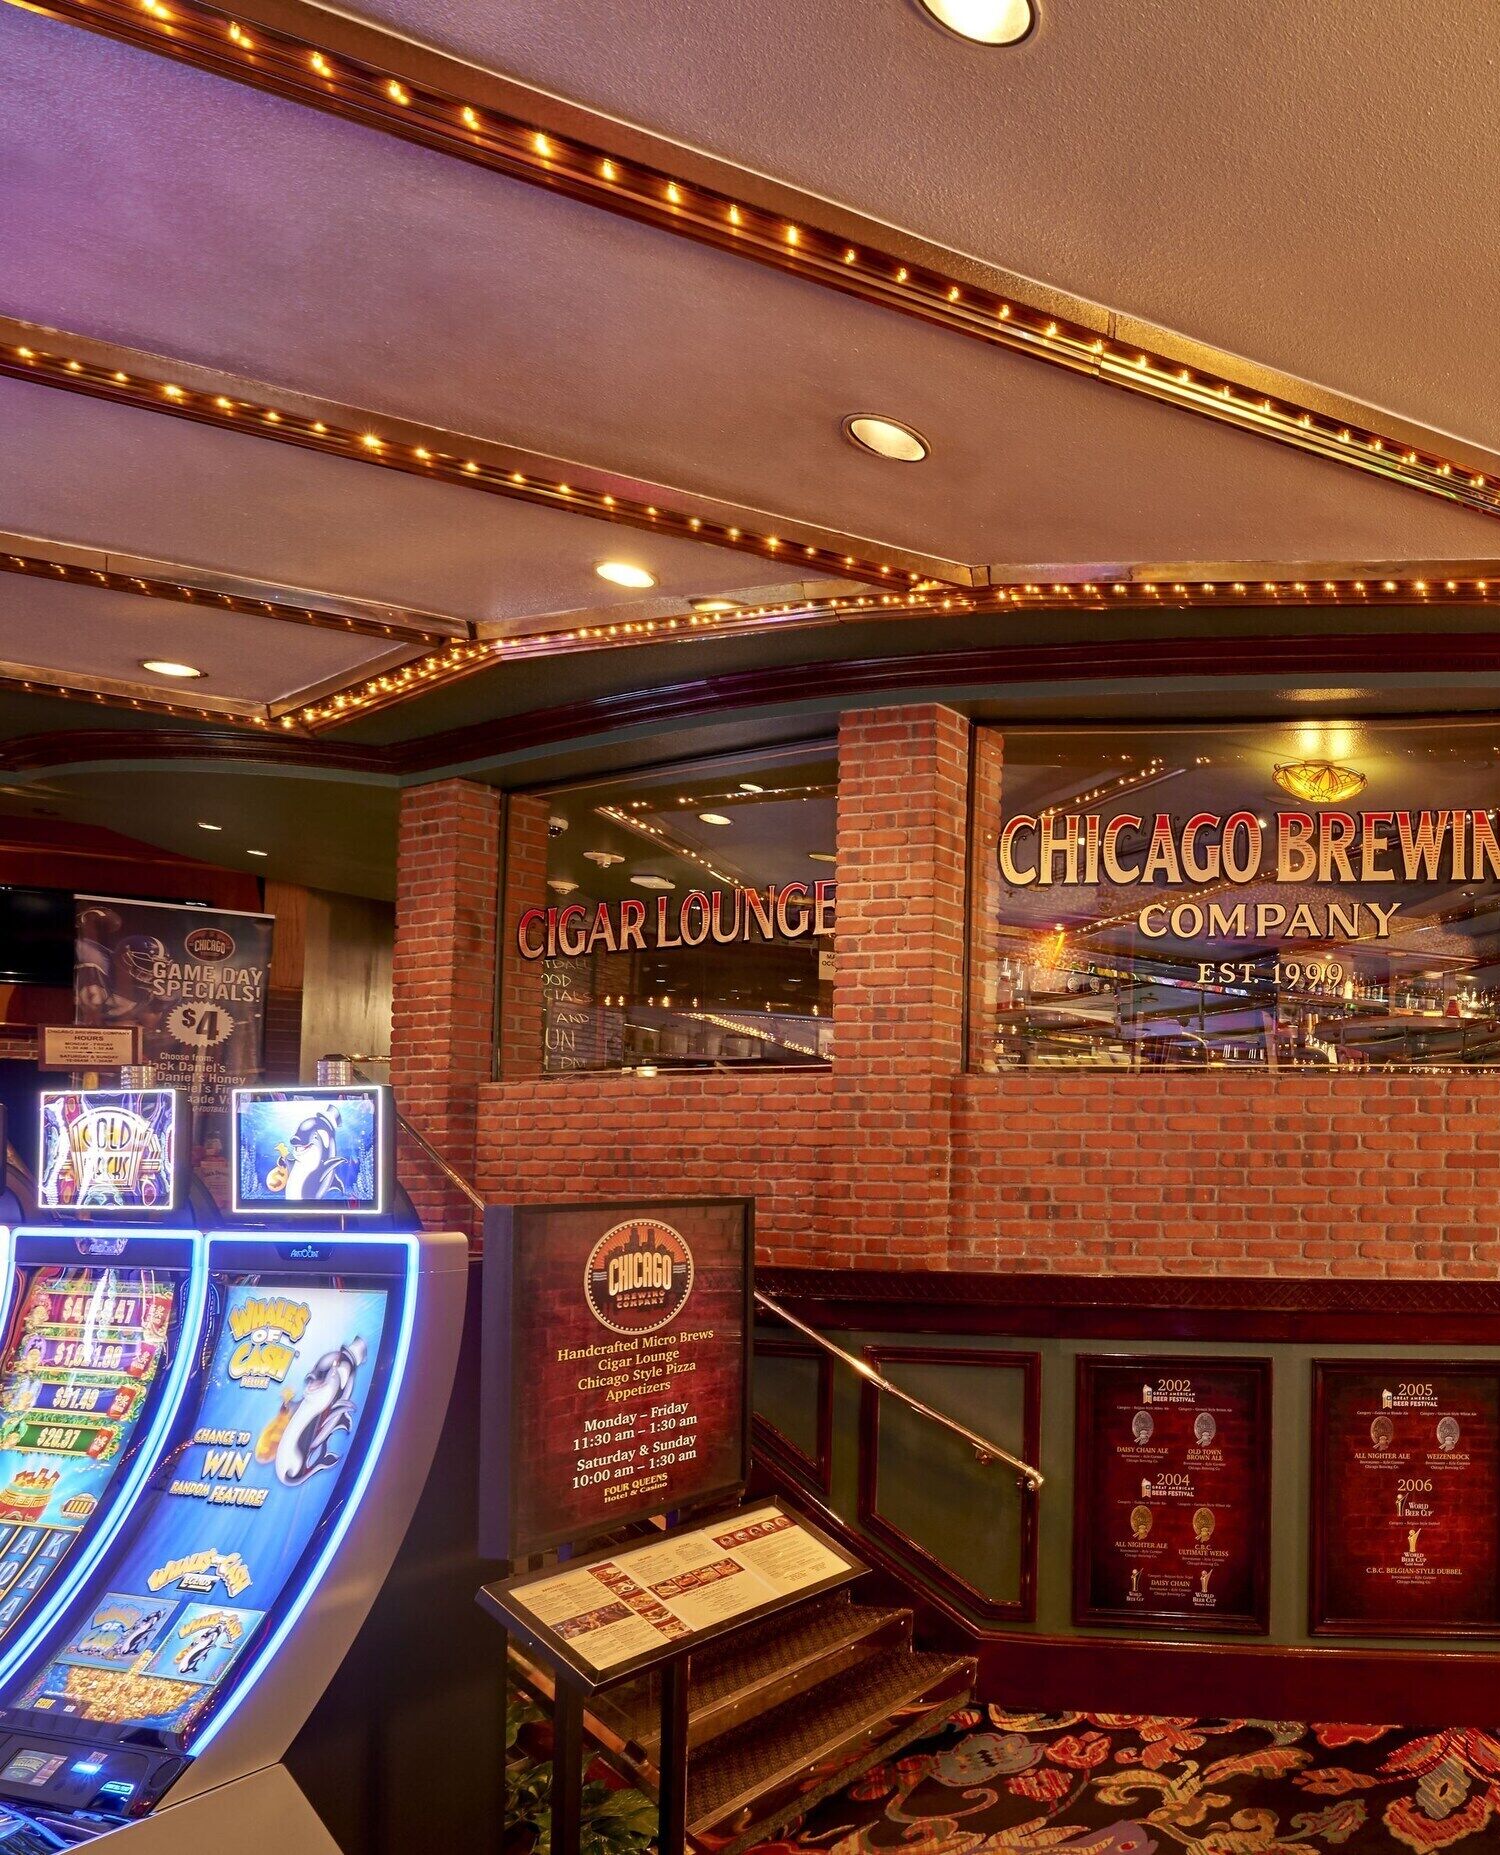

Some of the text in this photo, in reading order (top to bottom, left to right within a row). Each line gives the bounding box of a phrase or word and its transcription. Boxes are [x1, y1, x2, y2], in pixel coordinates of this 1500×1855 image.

[999, 812, 1263, 886] CHICAGO
[518, 877, 837, 961] CIGAR LOUNGE
[1138, 902, 1402, 940] COMPANY
[195, 940, 225, 954] CHICAGO
[153, 962, 262, 985] GAME DAY
[541, 974, 571, 987] OOD
[1197, 962, 1345, 990] EST. 1999
[153, 979, 260, 1002] SPECIALS!
[160, 1052, 214, 1062] Choose from:
[179, 1061, 226, 1073] Daniel's
[157, 1072, 246, 1085] Daniel's Honey
[609, 1252, 671, 1296] CHICAGO
[617, 1290, 665, 1301] BREWING
[617, 1298, 664, 1308] COMPANY
[228, 1297, 311, 1343] WHALES
[252, 1330, 282, 1344] OF
[557, 1330, 714, 1361] Handcrafted Micro Brews
[229, 1343, 295, 1383] CASH
[598, 1350, 679, 1371] Cigar Lounge
[578, 1361, 696, 1390] Chicago Style Pizza
[1158, 1379, 1191, 1391] 2002
[606, 1381, 671, 1402] Appetizers
[1399, 1384, 1432, 1396] 2005
[584, 1413, 637, 1432] Monday
[650, 1403, 689, 1418] Friday
[194, 1428, 251, 1445] CHANCE TO
[573, 1432, 611, 1451] 11:30
[615, 1430, 634, 1441] am
[650, 1418, 675, 1433] 1:30
[680, 1416, 698, 1426] am
[577, 1435, 696, 1471] Saturday & Sunday
[201, 1449, 252, 1481] WIN
[573, 1470, 610, 1489] 10:00
[614, 1466, 634, 1478] am
[649, 1454, 674, 1469] 1:30
[679, 1450, 696, 1461] am
[604, 1473, 668, 1496] FOUR QUEENS
[1157, 1473, 1190, 1486] 2004
[1398, 1479, 1432, 1491] 2006
[169, 1480, 269, 1507] RANDOM FEATURE!
[605, 1492, 628, 1503] Hotel
[640, 1482, 667, 1493] Casino
